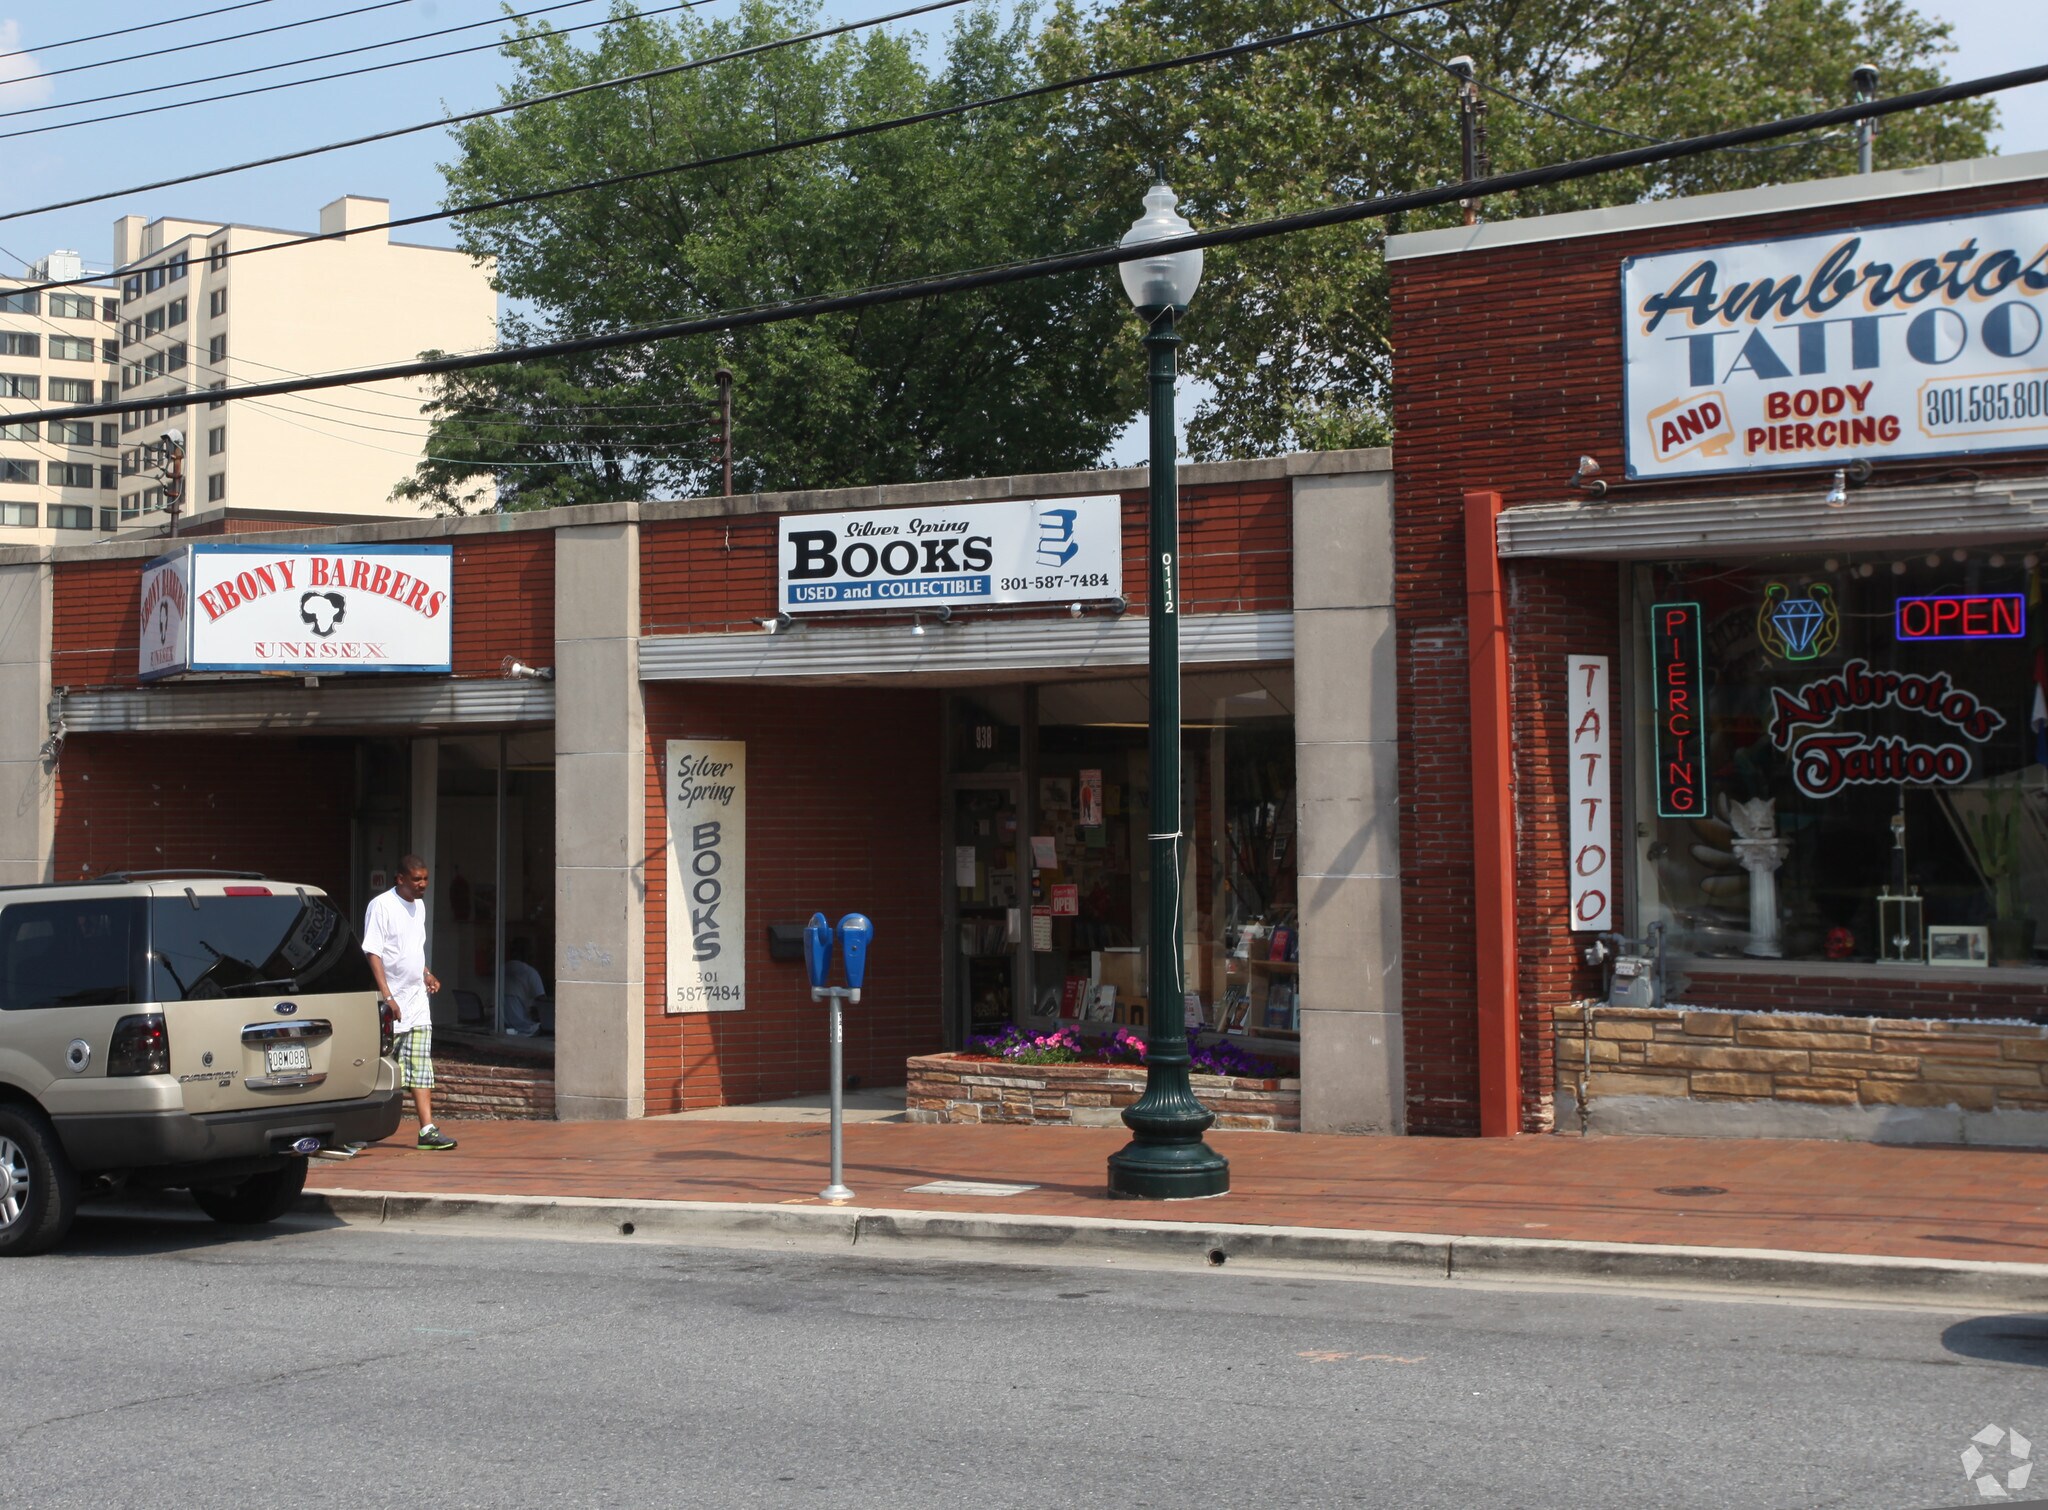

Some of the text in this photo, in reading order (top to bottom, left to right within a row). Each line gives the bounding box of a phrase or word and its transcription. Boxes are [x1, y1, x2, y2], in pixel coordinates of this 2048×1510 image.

[1665, 301, 2042, 388] TATTOO
[1764, 380, 1874, 423] BODY
[1660, 401, 1722, 453] AND
[1744, 415, 1901, 456] PIERCING
[844, 517, 970, 538] Silver Spring
[787, 528, 993, 580] BOOKS
[197, 556, 447, 624] EBONY BARBERS
[796, 578, 982, 601] USED and COLLECTIBLE
[1000, 572, 1110, 591] 301-587-7484
[1162, 552, 1175, 614] 01112
[141, 573, 161, 636] EBONY
[1901, 597, 2021, 638] OPEN
[255, 641, 389, 659] UNISEX
[1665, 610, 1694, 811] PIERCING
[1769, 658, 2006, 751] Ambrotos
[976, 726, 992, 749] 938
[677, 754, 733, 778] Silver
[1793, 732, 1972, 798] Tattoo
[677, 776, 736, 809] Spring
[1575, 662, 1607, 923] TATTOO
[691, 821, 722, 962] BOOKS
[1053, 896, 1076, 912] OPEN
[677, 985, 740, 1001] 587-7484
[696, 971, 718, 983] 301
